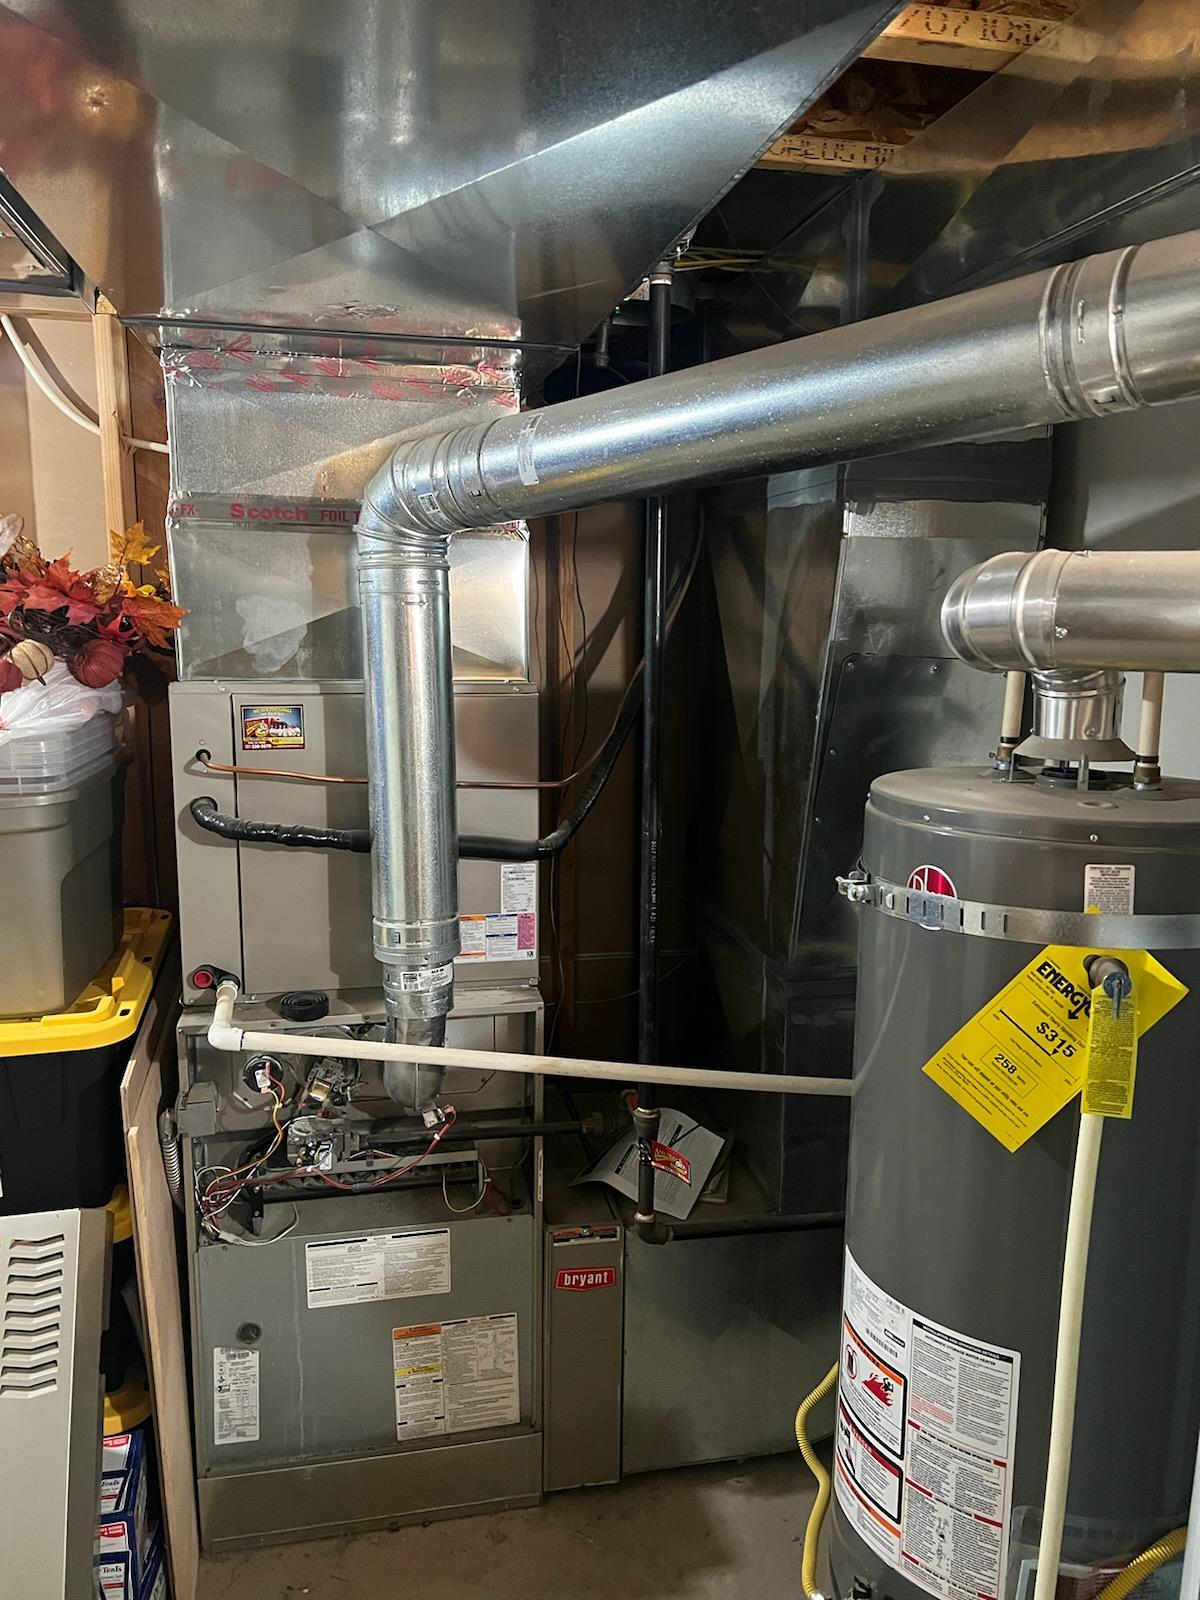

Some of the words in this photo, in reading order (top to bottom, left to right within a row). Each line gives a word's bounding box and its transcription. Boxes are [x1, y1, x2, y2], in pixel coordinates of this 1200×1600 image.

[230, 503, 309, 521] Scotch
[320, 509, 348, 522] FOIL
[1036, 1022, 1076, 1058] $315
[994, 1053, 1017, 1075] 258
[564, 1272, 608, 1287] bryant
